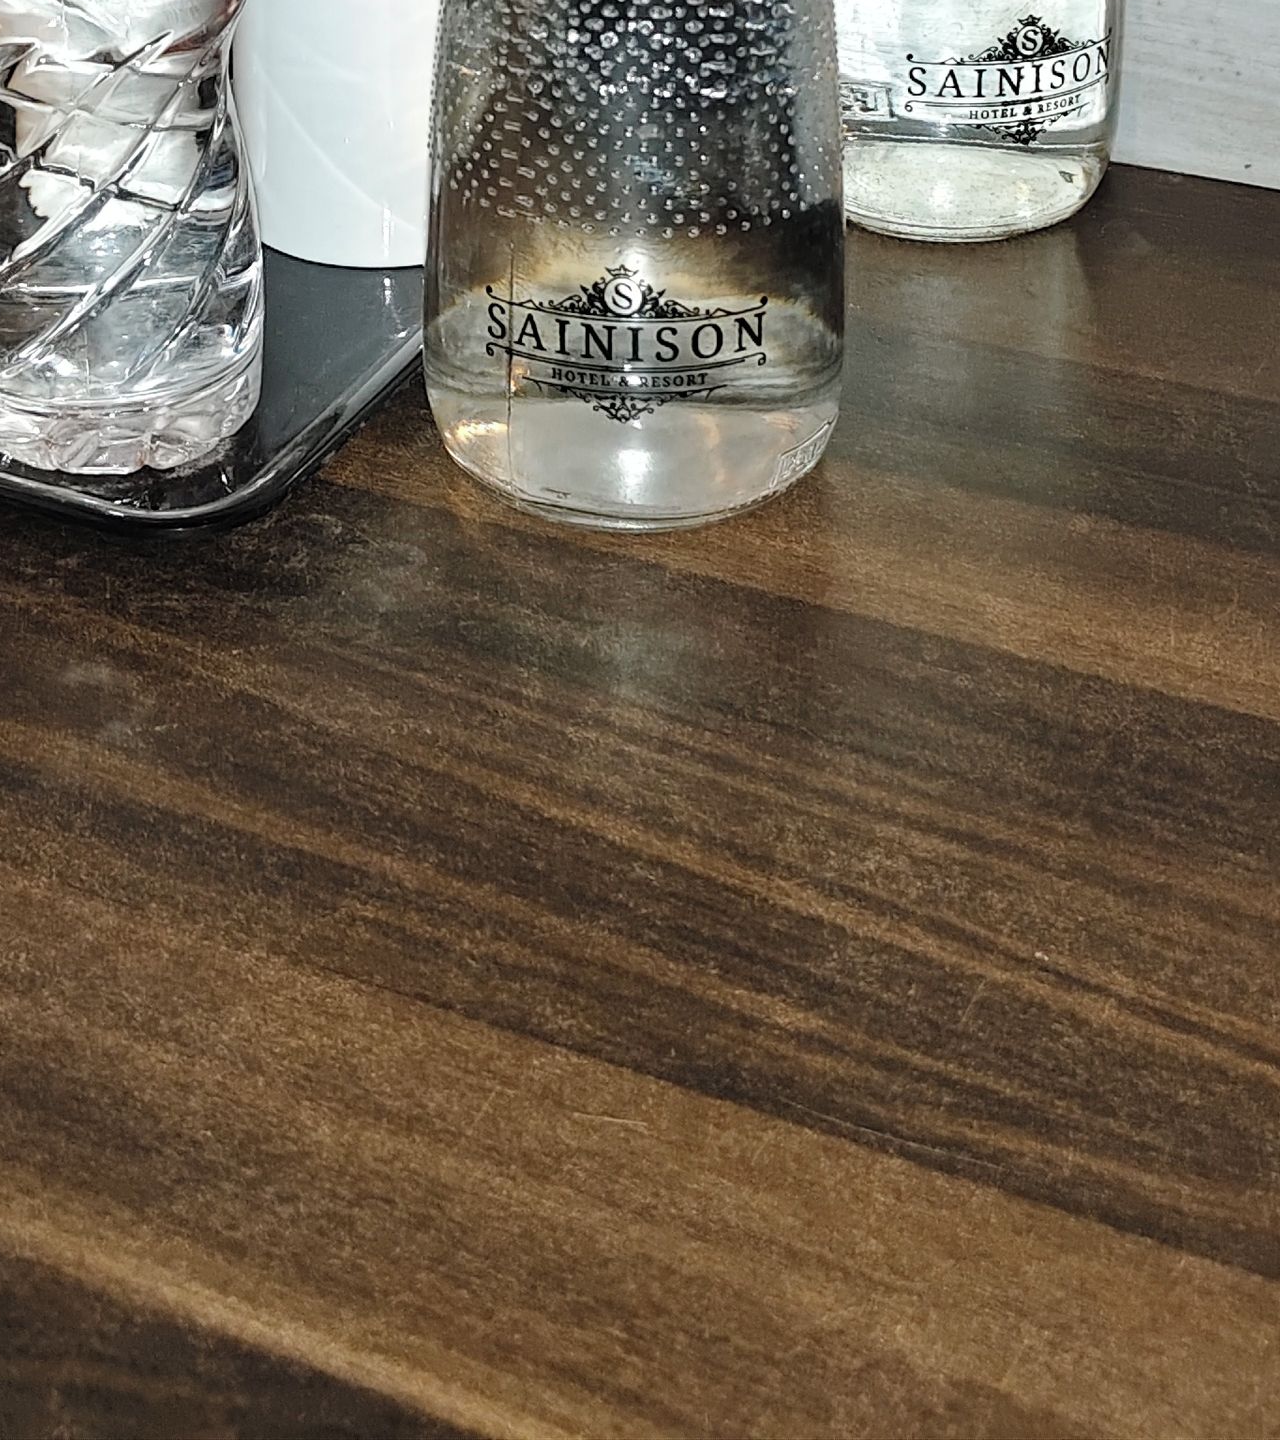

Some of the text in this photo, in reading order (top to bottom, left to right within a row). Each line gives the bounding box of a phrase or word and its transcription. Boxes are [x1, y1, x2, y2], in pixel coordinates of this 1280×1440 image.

[1022, 29, 1038, 51] S
[907, 39, 1112, 98] SAINISON
[969, 93, 1082, 120] HOTEL & RESORT
[611, 283, 633, 309] S
[486, 302, 767, 363] SAINISON
[551, 367, 709, 388] HOTEL & RESORT
